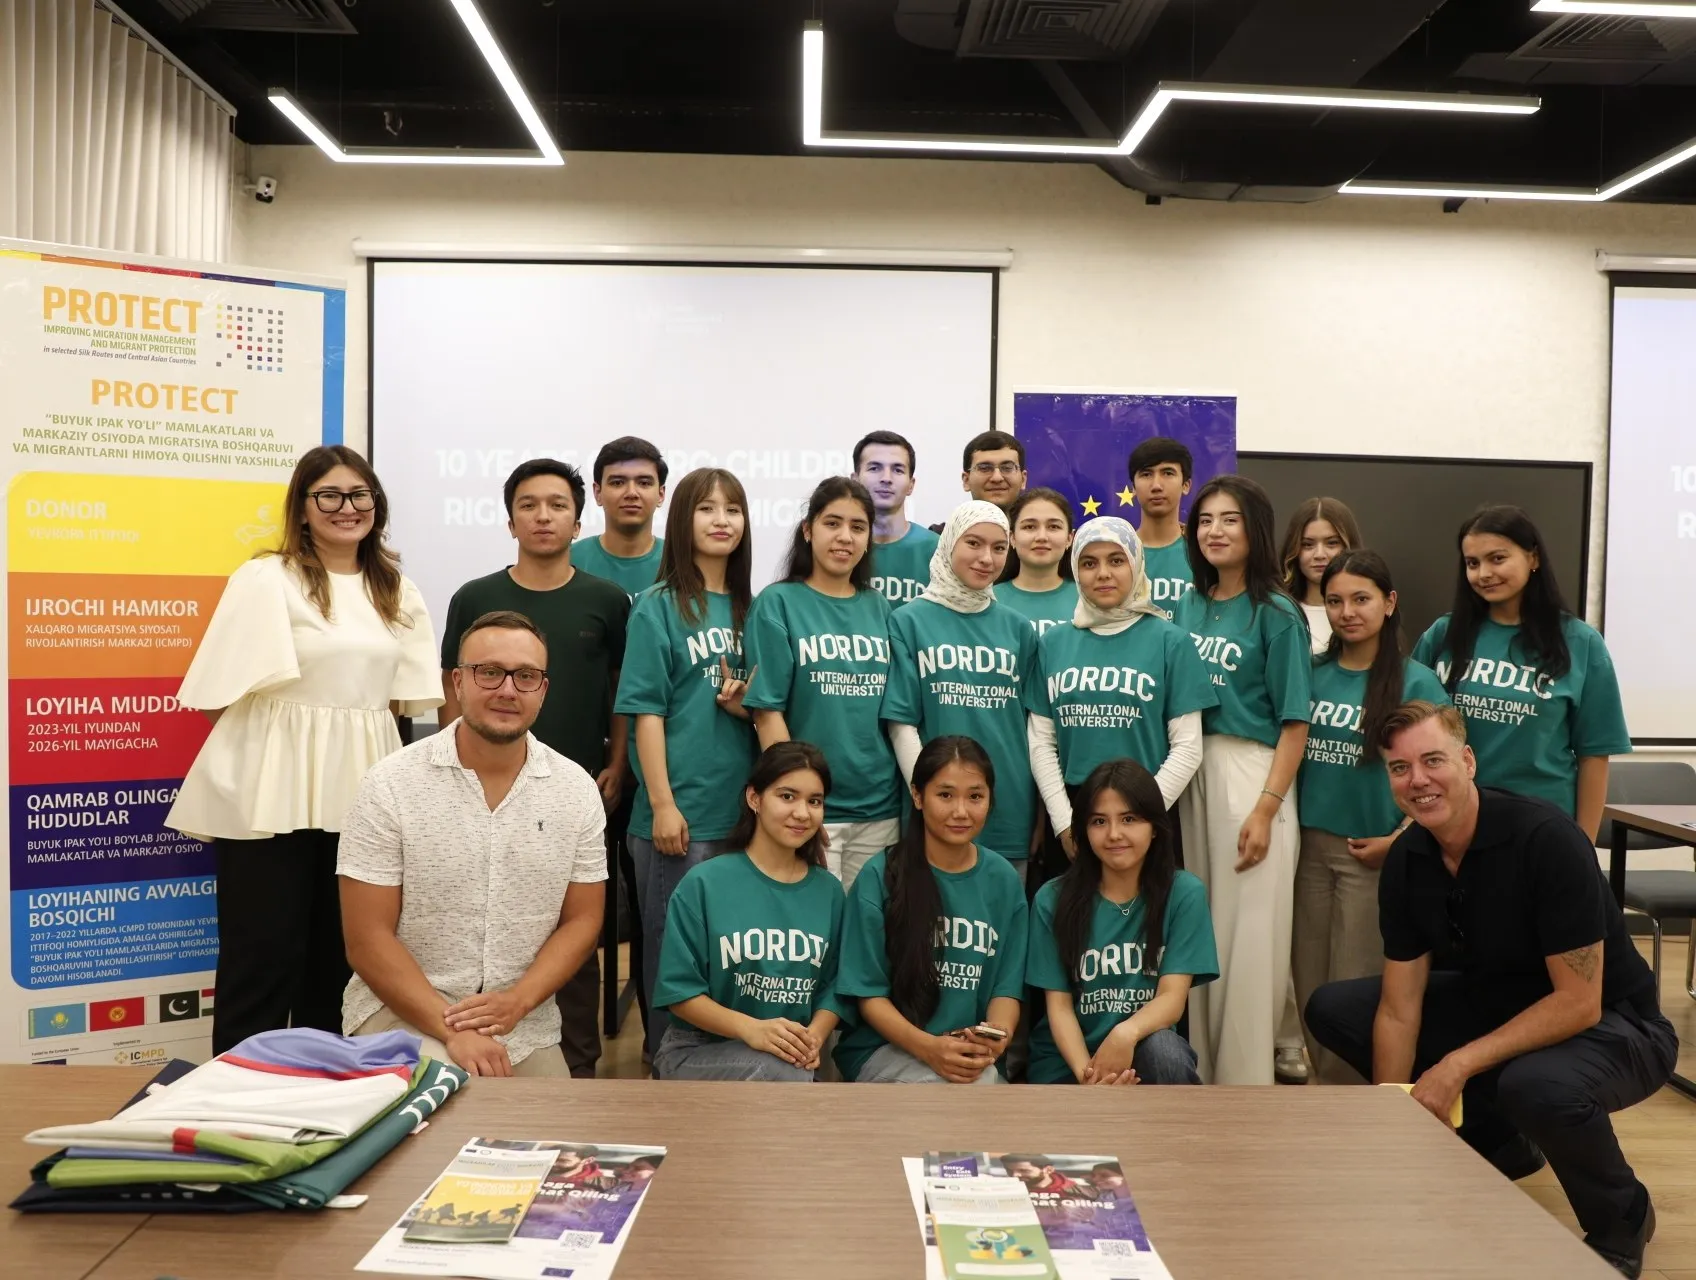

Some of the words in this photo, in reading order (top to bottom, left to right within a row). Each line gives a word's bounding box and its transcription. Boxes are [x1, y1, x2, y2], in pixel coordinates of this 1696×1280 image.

[44, 286, 202, 333] PROTECT
[44, 325, 91, 336] IMPROVING
[93, 329, 138, 340] MIGRATION
[140, 334, 196, 346] MANAGEMENT
[52, 347, 77, 355] selected
[92, 351, 113, 359] Routes
[128, 353, 149, 361] Central
[169, 357, 196, 365] Countries
[91, 339, 108, 348] AND
[110, 342, 146, 352] MIGRANT
[149, 344, 196, 356] PROTECTION
[92, 379, 238, 414] PROTECT
[45, 414, 93, 426] “BUYUK
[97, 418, 123, 428] IPAK
[166, 422, 256, 436] MAMLAKATLARI
[260, 428, 274, 438] VA
[23, 428, 88, 441] MARKAZIY
[92, 432, 145, 445] OSIYODA
[149, 435, 218, 449] MIGRATSIYA
[222, 440, 293, 453] BOSHQARUVI
[13, 442, 29, 452] VA
[34, 444, 128, 458] MIGRANTLARNI
[132, 449, 179, 461] HIMOYA
[183, 452, 231, 464] QILISHNI
[436, 449, 469, 478] 10
[727, 449, 853, 479] CHILDR
[26, 499, 107, 519] DONOR
[26, 599, 104, 616] IJROCHI
[112, 600, 199, 616] HAMKOR
[26, 625, 74, 635] XALQARO
[78, 625, 136, 634] MIGRATSIYA
[140, 625, 180, 634] SIYOSATI
[26, 638, 104, 648] RIVOJLANTIRISH
[108, 638, 152, 647] MARKAZI
[156, 638, 192, 648] (ICMPD)
[799, 634, 890, 666] NORDI
[810, 672, 886, 684] INTERNATION
[1048, 666, 1156, 704] NORDIC
[930, 682, 1018, 698] INTERNATIONAL
[26, 697, 104, 715] LOYIHA
[939, 695, 1007, 708] UNIVERSITY
[1060, 716, 1133, 728] UNIVERSITY
[1310, 701, 1365, 734] RDI
[28, 723, 81, 735] 2023-YIL
[85, 722, 141, 733] IYUNDAN
[28, 740, 81, 752] 2026-YIL
[85, 738, 158, 750] MAYIGACHA
[27, 792, 108, 811] QAMRAB
[28, 810, 129, 829] HUDUDLAR
[28, 839, 61, 850] BUYUK
[64, 838, 85, 848] IPAK
[88, 837, 111, 847] YO'LI
[115, 834, 153, 845] BO'YLAB
[28, 852, 104, 864] MAMLAKATLAR
[108, 850, 120, 859] VA
[123, 846, 172, 857] MARKAZIY
[175, 843, 203, 853] OSIYO
[29, 886, 140, 909] LOYIHANING
[146, 881, 217, 900] AVVALGI
[29, 907, 115, 927] BOSQICHI
[79, 927, 116, 936] YILLARDA
[119, 923, 144, 933] ICMPD
[147, 919, 195, 930] TOMONIDAN
[30, 942, 64, 952] ITTIFOQI
[67, 937, 120, 948] HOMIYLIGIDA
[123, 934, 156, 943] AMALGA
[159, 929, 204, 939] OSHIRILGAN
[720, 928, 829, 969] NORDI
[65, 951, 82, 959] IPAK
[84, 949, 103, 957] YO'LI
[106, 942, 178, 956] MAMLAKATLARIDA
[30, 961, 92, 973] BOSHQARUVINI
[31, 975, 64, 984] DAVOMI
[67, 969, 123, 980] HISOBLANADI.
[131, 1049, 164, 1060] ICMPD
